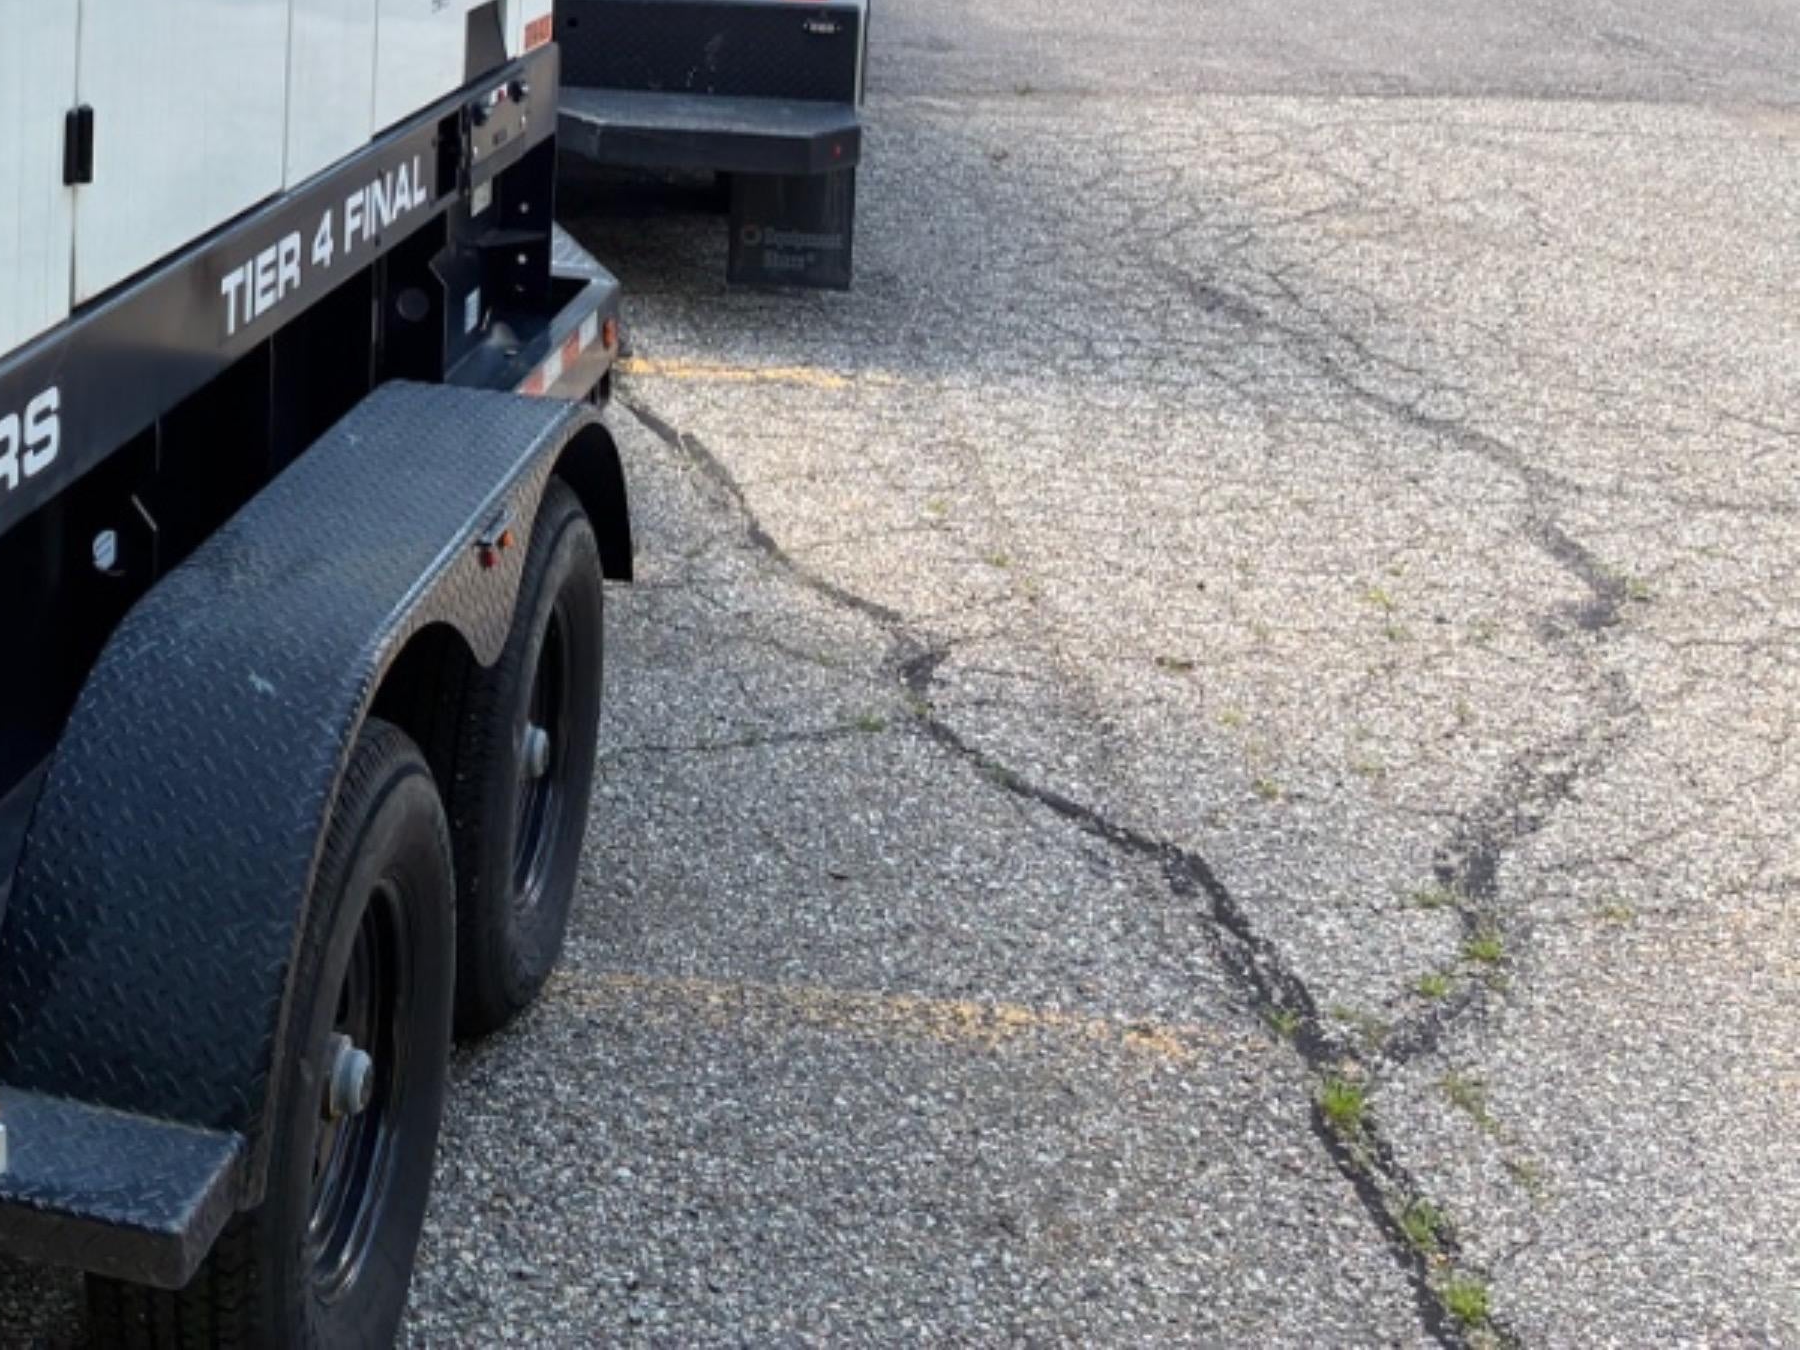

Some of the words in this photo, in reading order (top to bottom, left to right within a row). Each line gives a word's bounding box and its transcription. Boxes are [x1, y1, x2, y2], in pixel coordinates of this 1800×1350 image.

[220, 230, 302, 337] TIER
[311, 207, 335, 269] 4
[343, 154, 427, 255] FINAL
